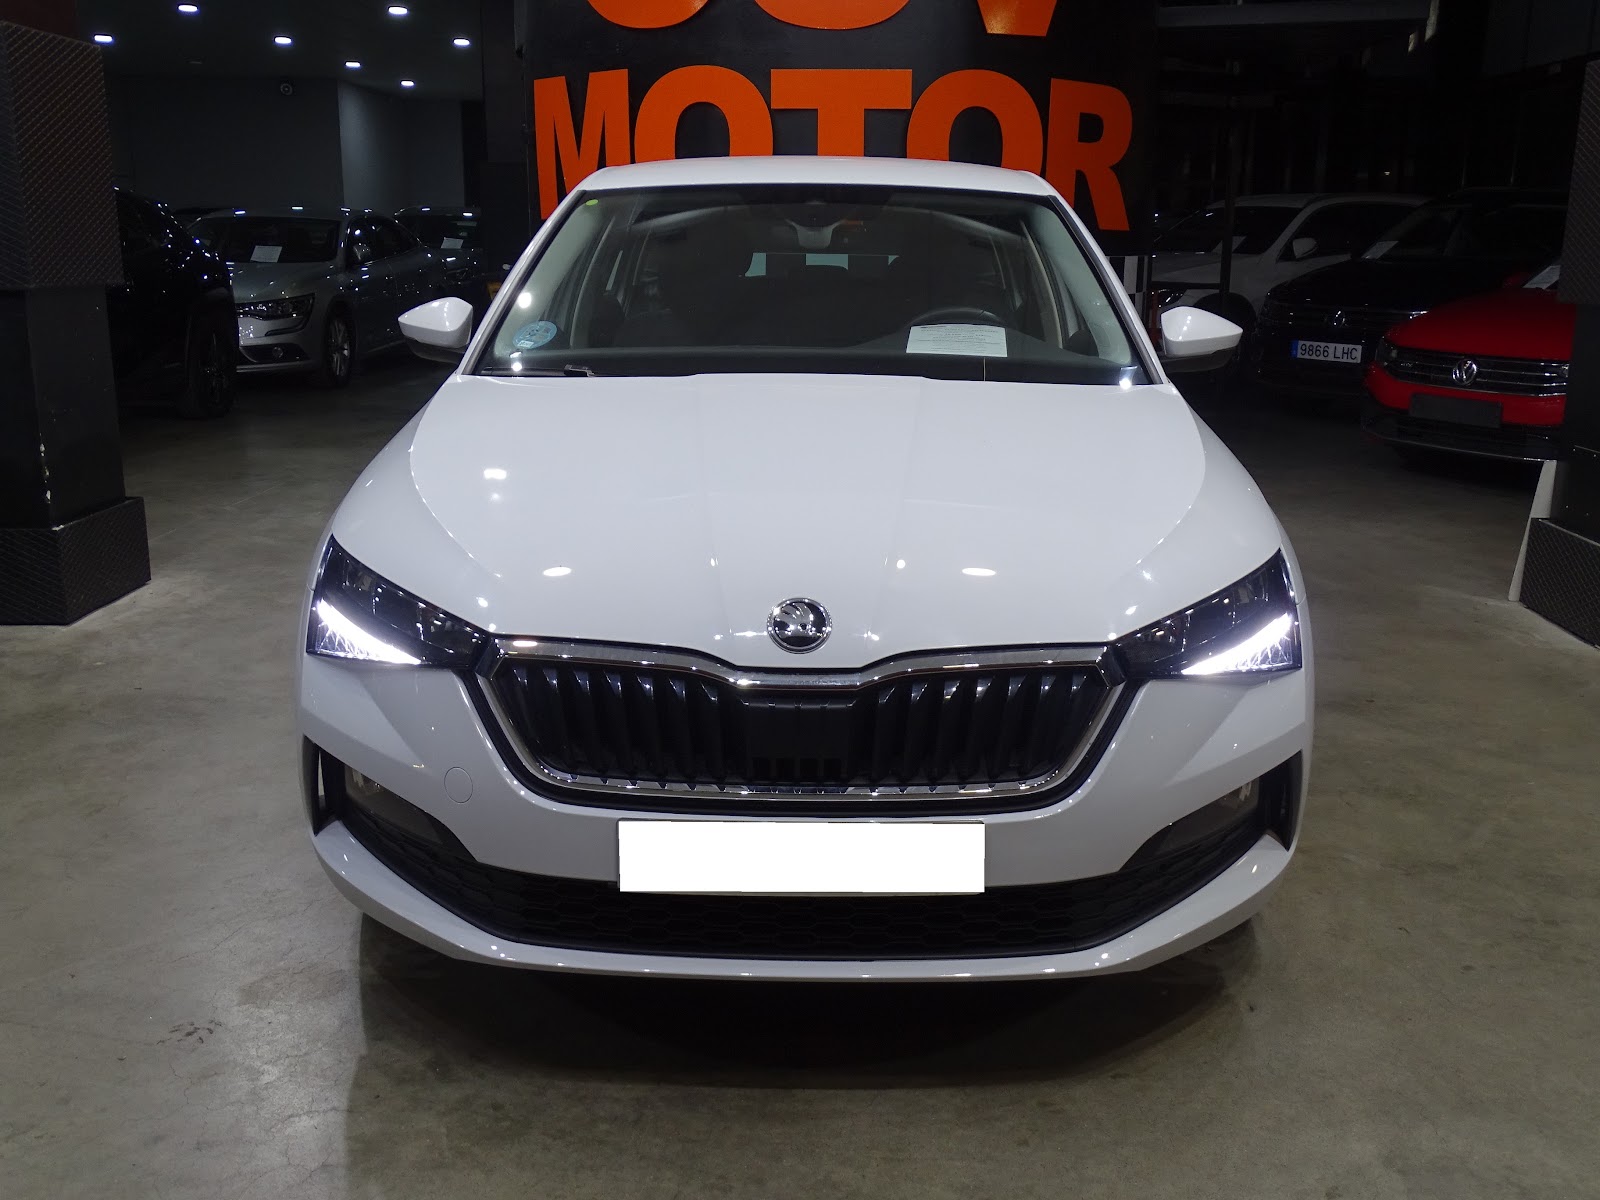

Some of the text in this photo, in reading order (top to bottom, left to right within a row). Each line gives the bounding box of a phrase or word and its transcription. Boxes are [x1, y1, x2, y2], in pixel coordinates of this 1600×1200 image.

[533, 65, 1133, 231] MOTOR
[1300, 343, 1358, 360] 9866 LHC
